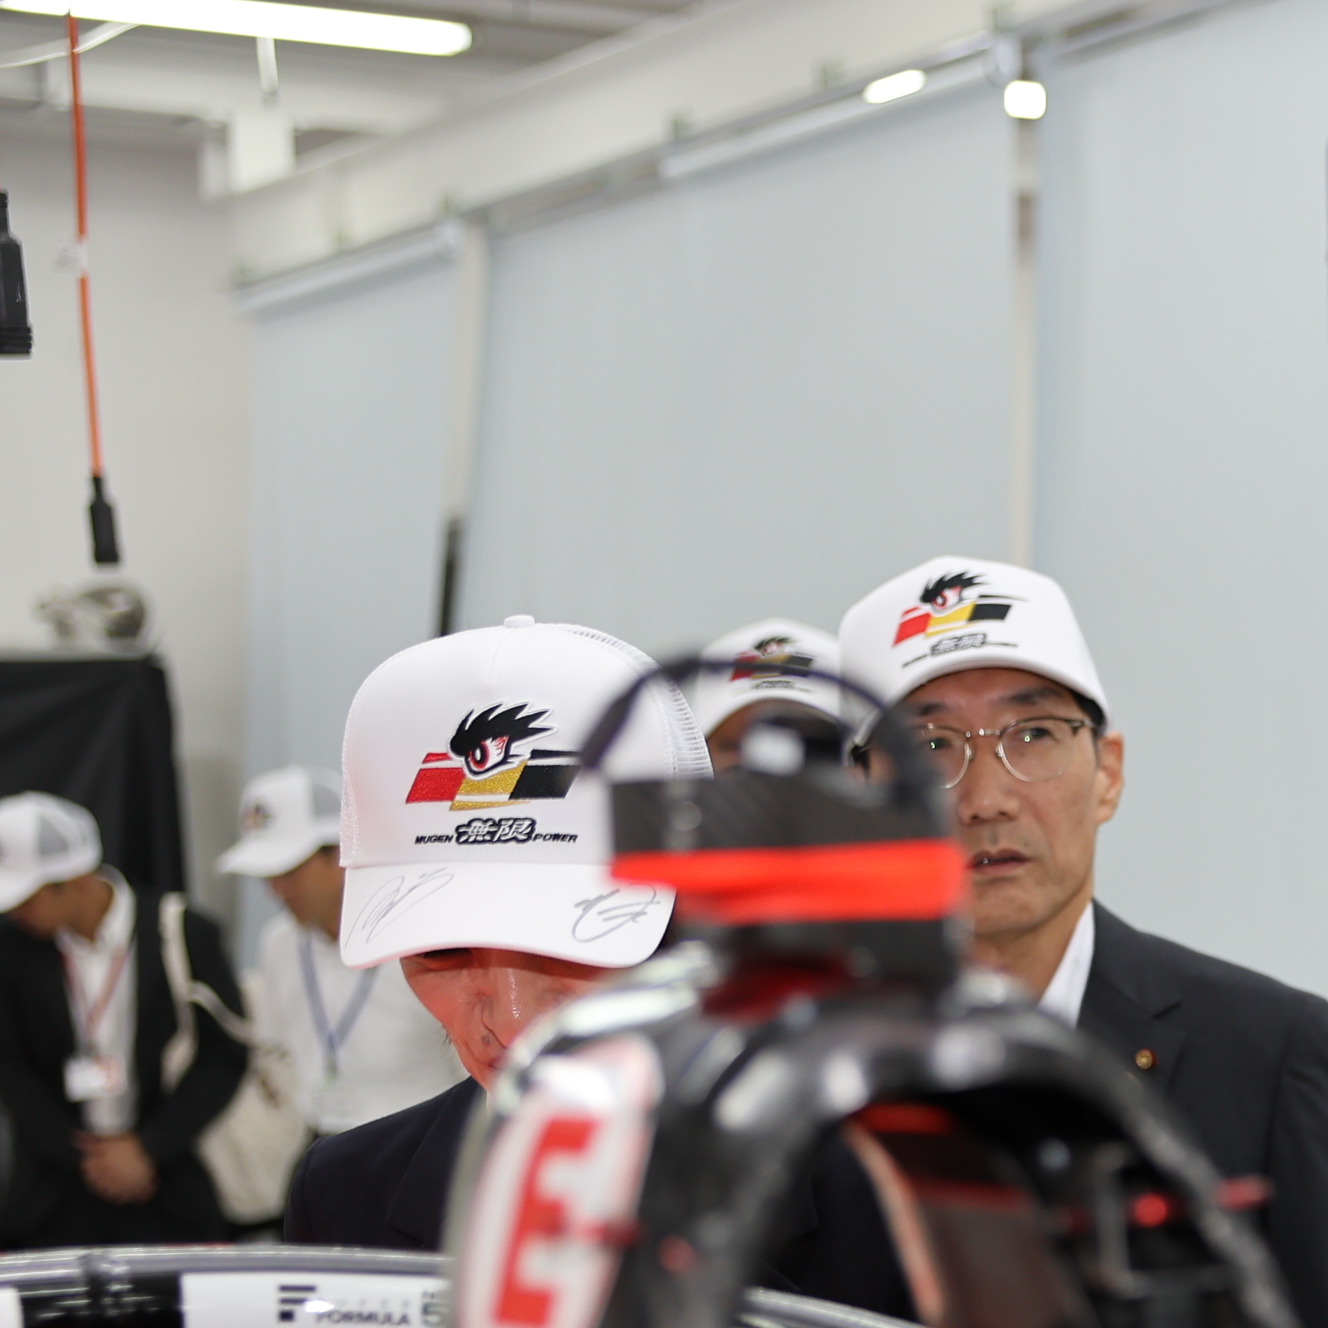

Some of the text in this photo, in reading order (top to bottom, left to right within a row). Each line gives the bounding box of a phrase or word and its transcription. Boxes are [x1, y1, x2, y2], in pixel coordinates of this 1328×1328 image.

[415, 817, 578, 845] MUGEN 無限 POWER
[315, 1310, 410, 1327] FORMULA
